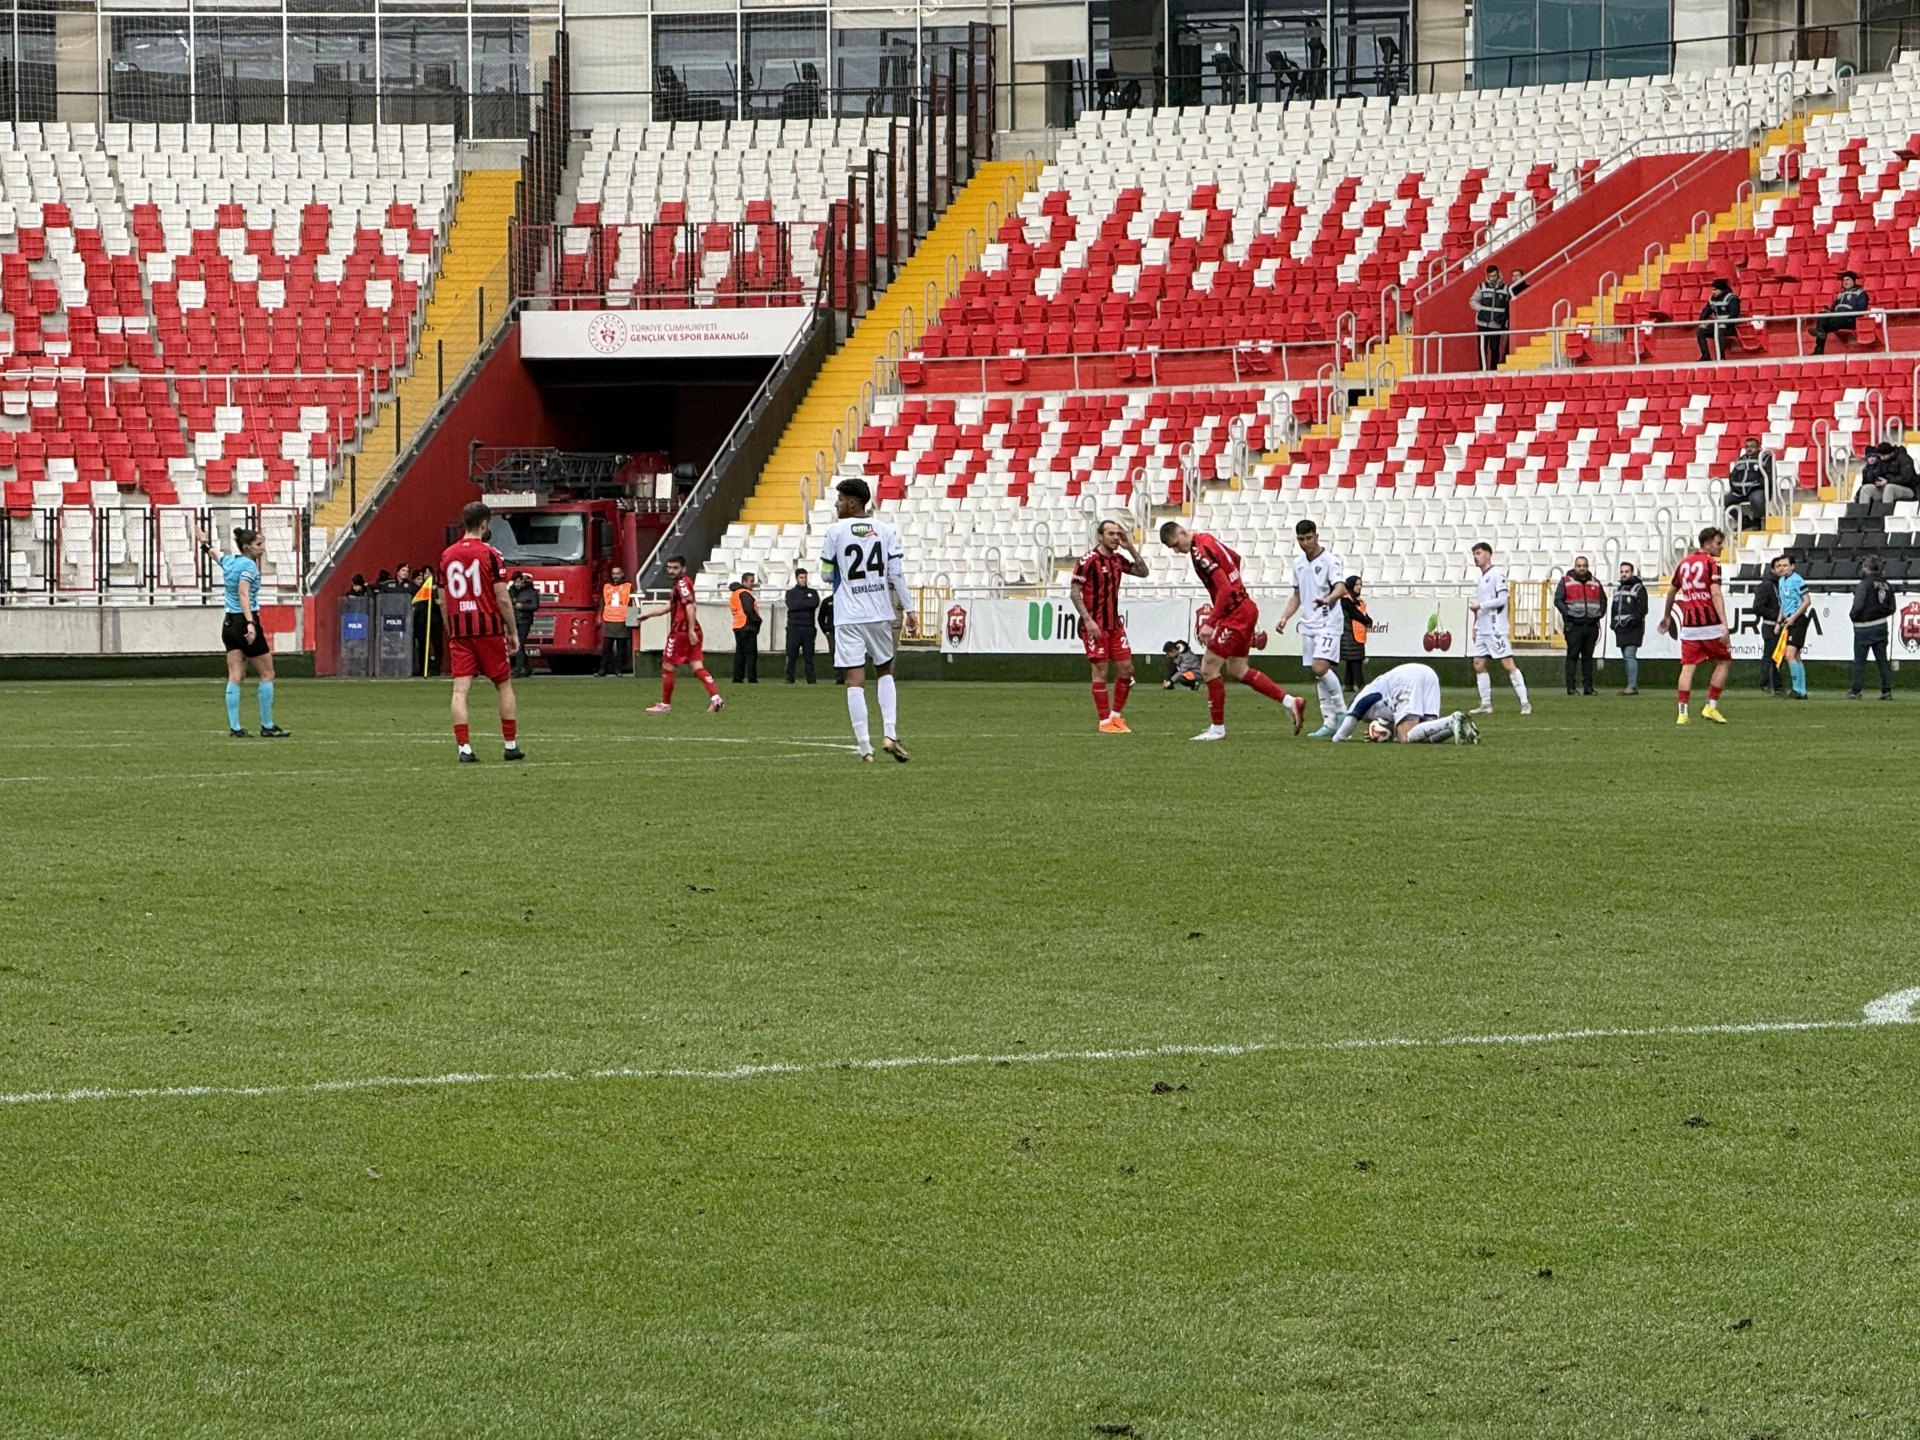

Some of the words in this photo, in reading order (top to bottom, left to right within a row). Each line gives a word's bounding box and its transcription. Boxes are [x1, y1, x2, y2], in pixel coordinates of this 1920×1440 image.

[630, 333, 665, 342] GENÇLİK
[704, 331, 749, 340] BAKANLIĞI
[845, 541, 885, 580] 24
[447, 559, 482, 598] 61
[1680, 561, 1706, 591] 22
[1322, 637, 1333, 648] 77
